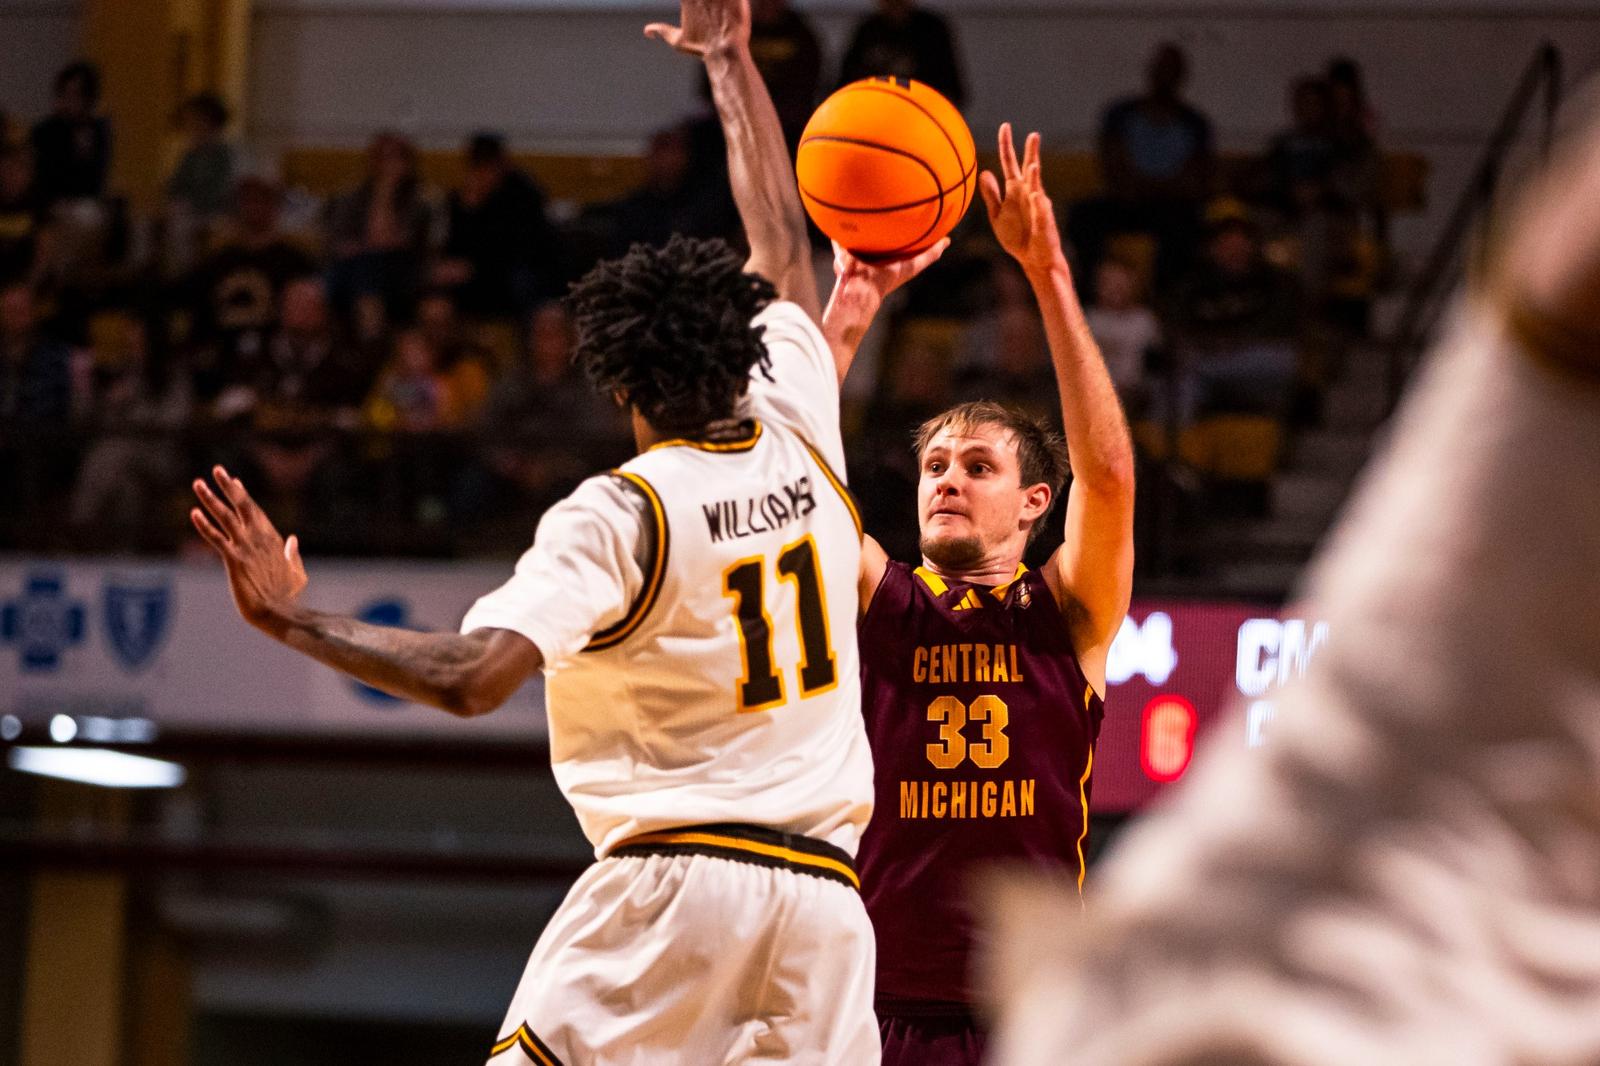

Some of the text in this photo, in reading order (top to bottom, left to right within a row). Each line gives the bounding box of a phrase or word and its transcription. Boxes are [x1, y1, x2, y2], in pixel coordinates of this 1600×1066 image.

[723, 533, 838, 713] 11
[913, 643, 1023, 683] CENTRAL
[926, 694, 1010, 770] 33
[900, 780, 1035, 819] MICHIGAN
